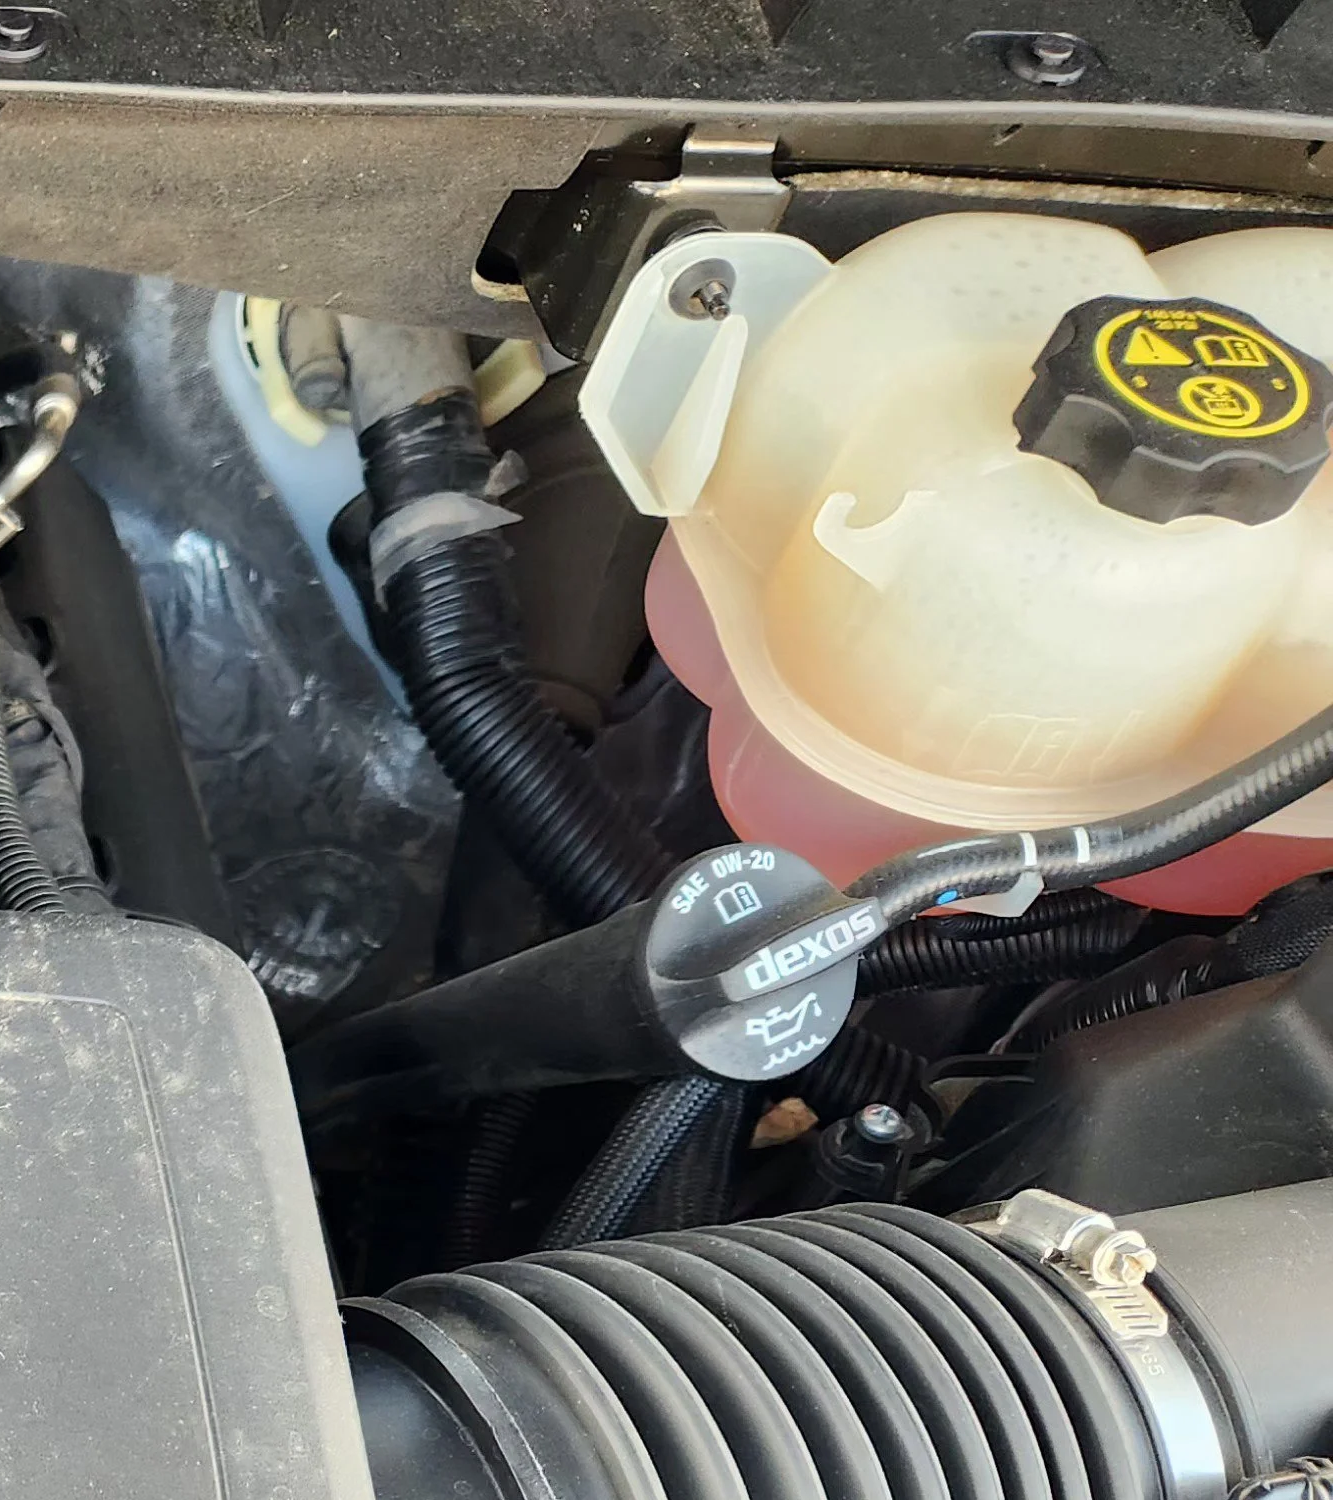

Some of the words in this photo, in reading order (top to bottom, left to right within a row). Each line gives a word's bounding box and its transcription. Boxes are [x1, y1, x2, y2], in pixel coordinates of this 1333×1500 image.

[671, 871, 710, 914] SAE
[712, 849, 775, 879] 0W-20
[744, 909, 876, 990] dexos
